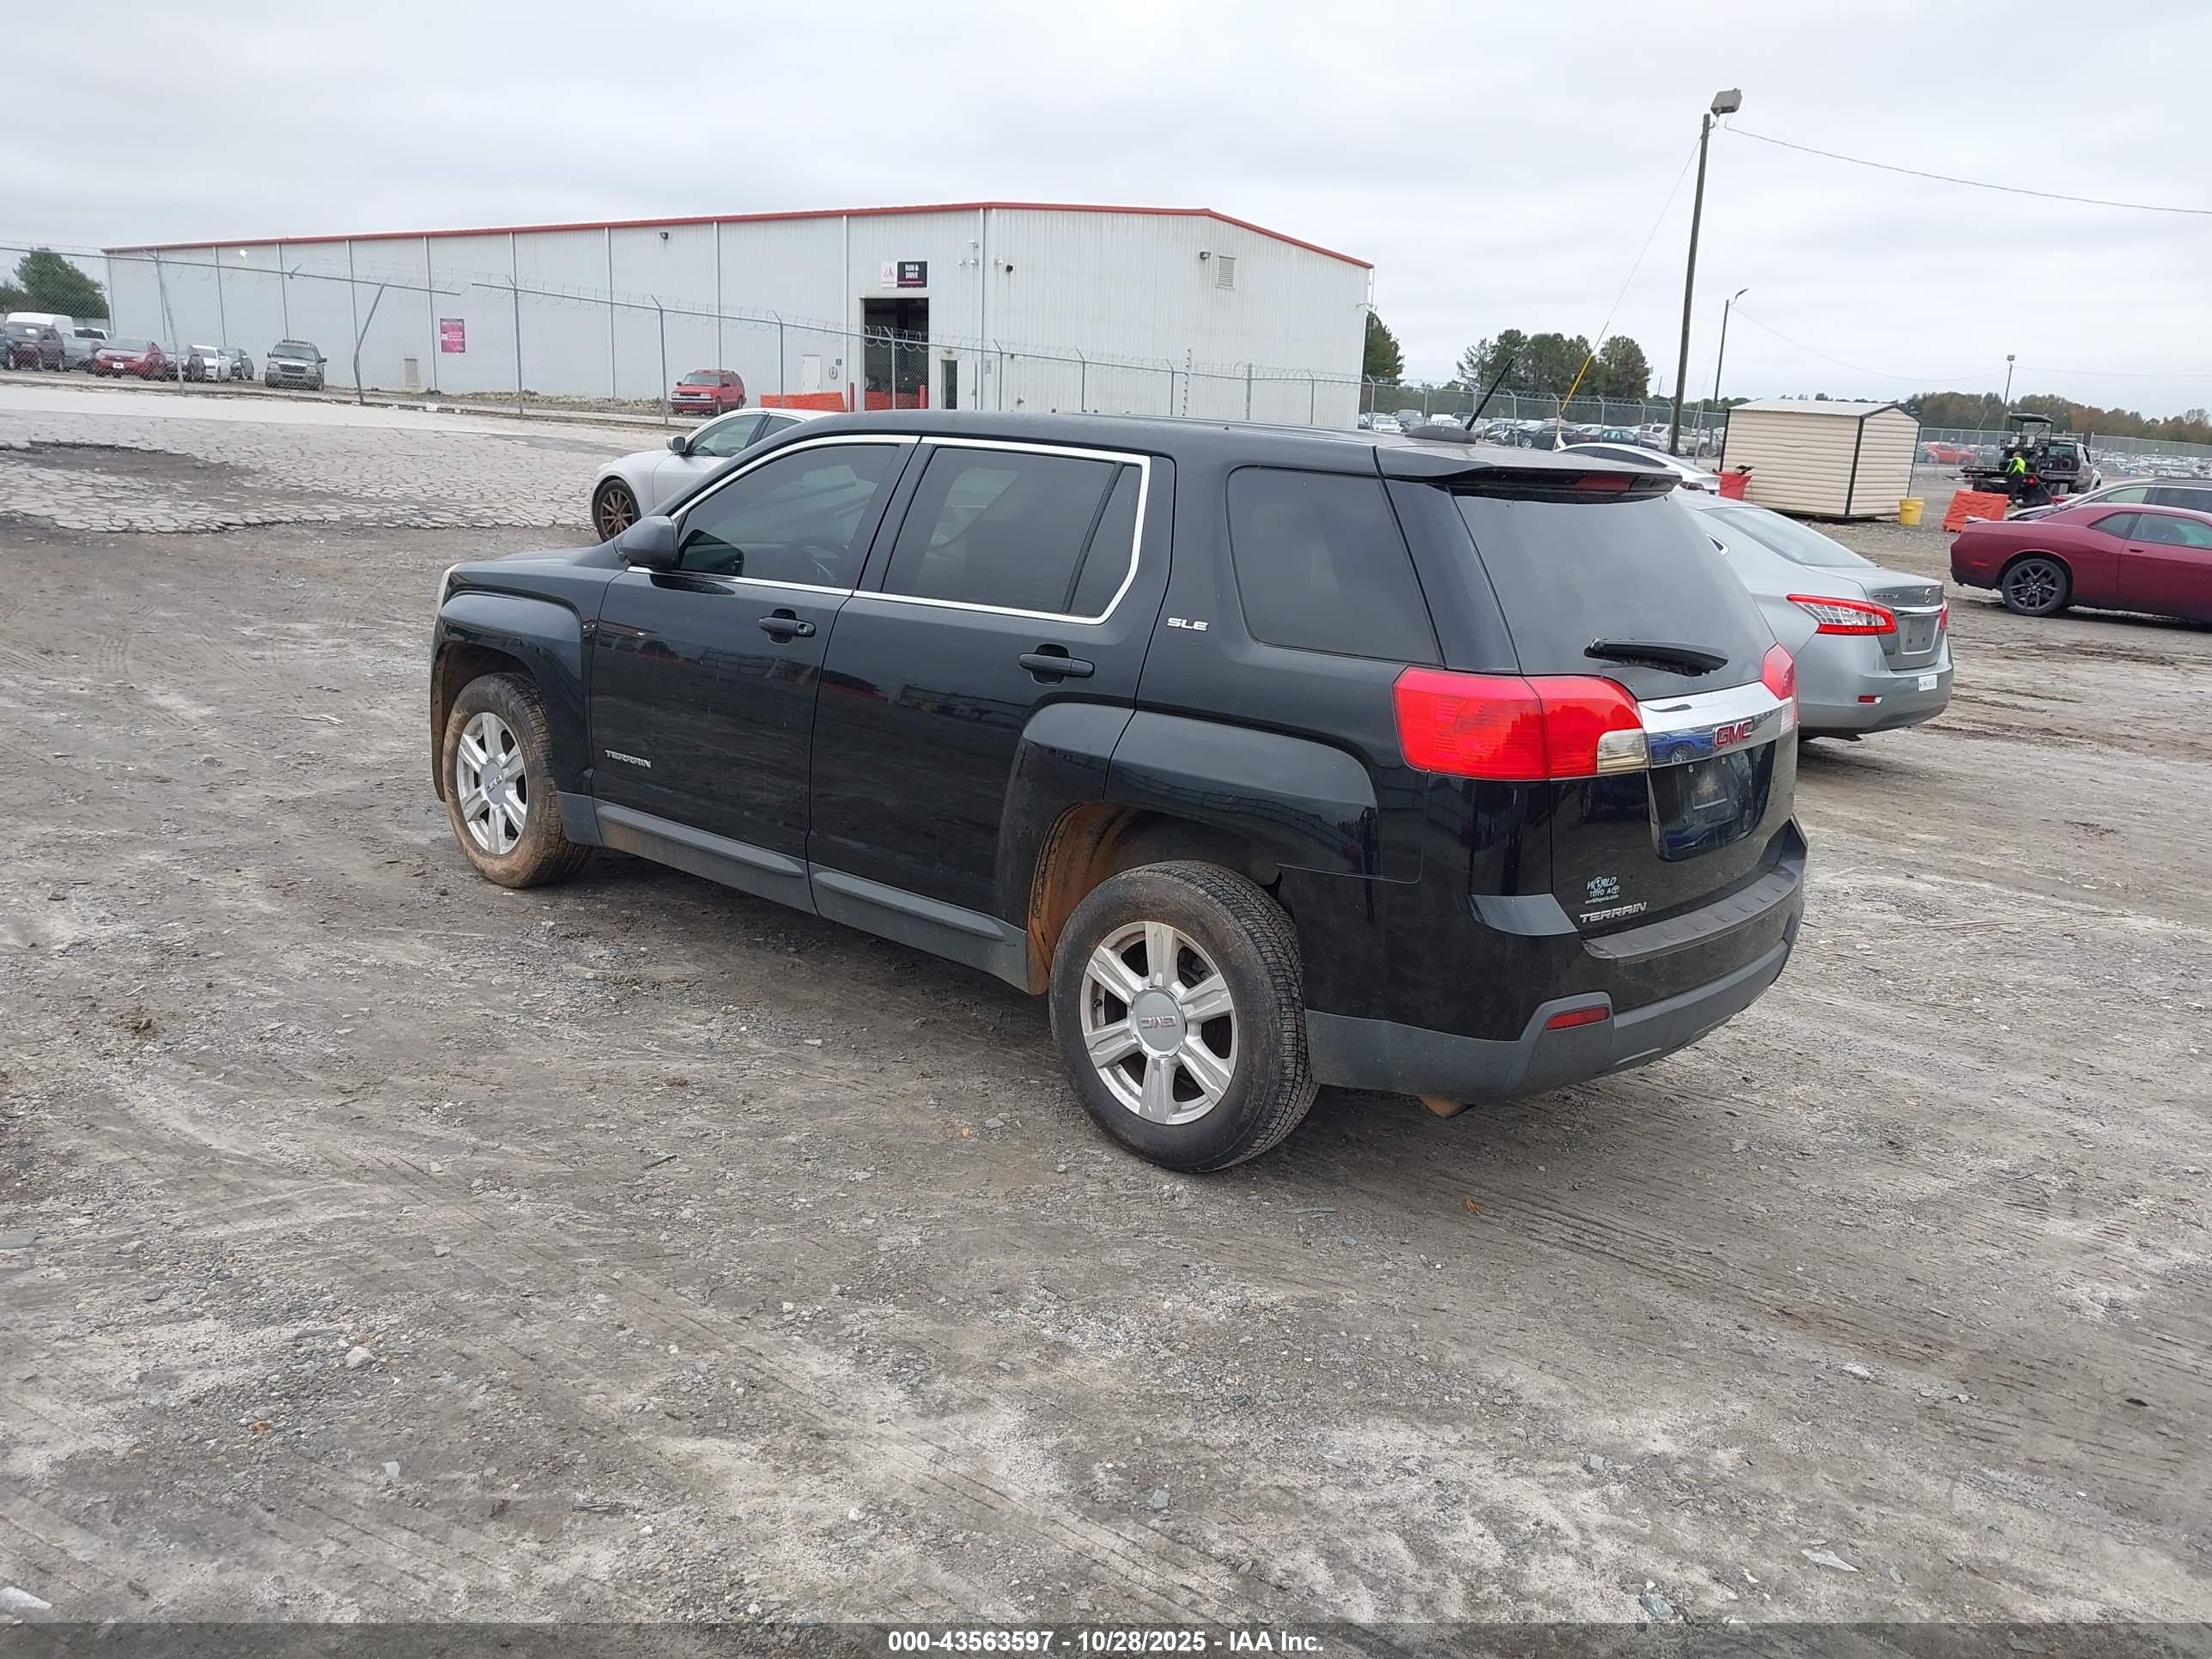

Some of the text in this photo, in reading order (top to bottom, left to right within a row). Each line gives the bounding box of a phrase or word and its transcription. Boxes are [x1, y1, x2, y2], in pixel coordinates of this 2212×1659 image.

[1166, 617, 1208, 631] SLE
[1712, 719, 1753, 747] GMC
[604, 749, 652, 769] TERRAIN
[1586, 876, 1617, 890] WORLD
[1579, 902, 1648, 923] TERRAIN
